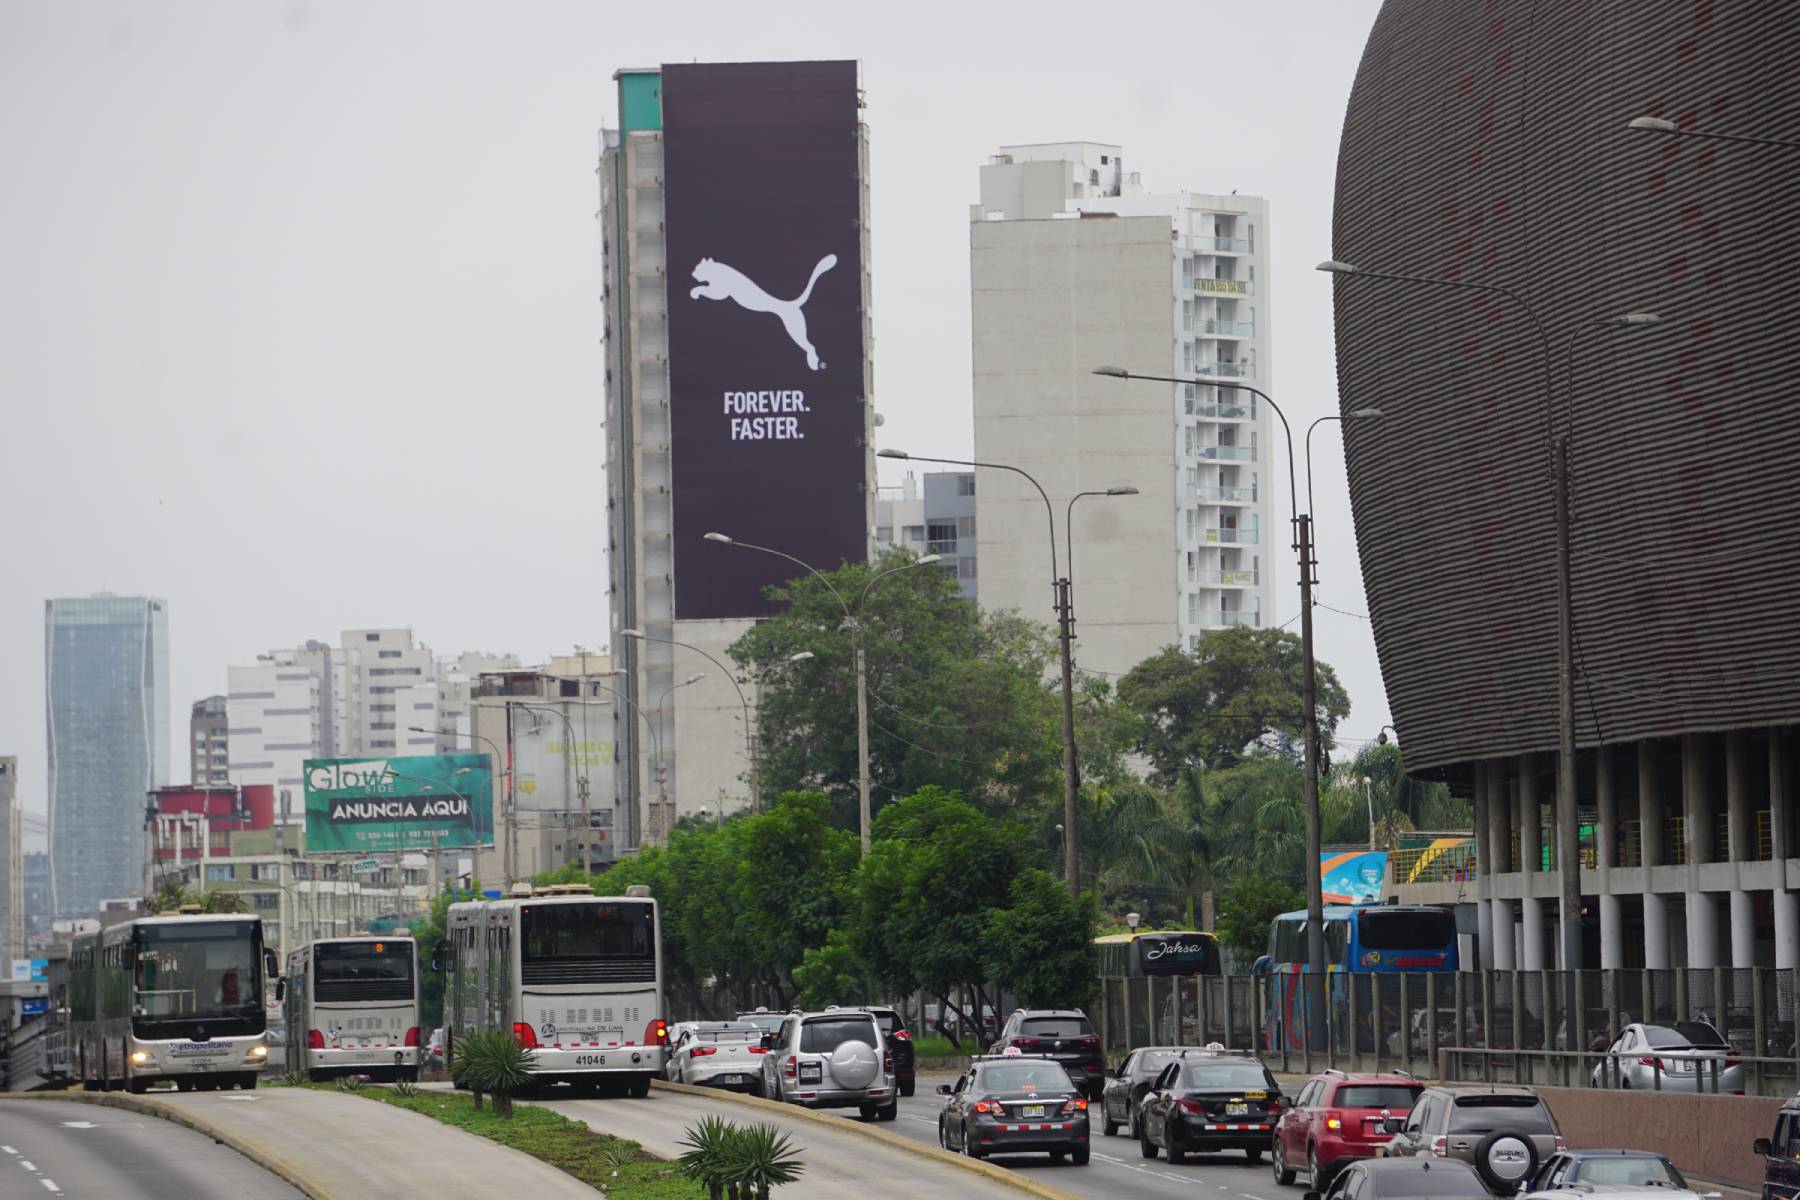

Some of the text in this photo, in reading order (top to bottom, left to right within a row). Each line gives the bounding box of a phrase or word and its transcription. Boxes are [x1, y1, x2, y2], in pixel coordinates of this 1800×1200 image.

[723, 390, 811, 414] FOREVER.
[731, 417, 804, 440] FASTER.
[364, 785, 395, 793] SIDE
[332, 801, 417, 819] ANUNCIA
[375, 943, 384, 953] B
[1147, 941, 1202, 960] Jaksa
[575, 1055, 606, 1066] 41046
